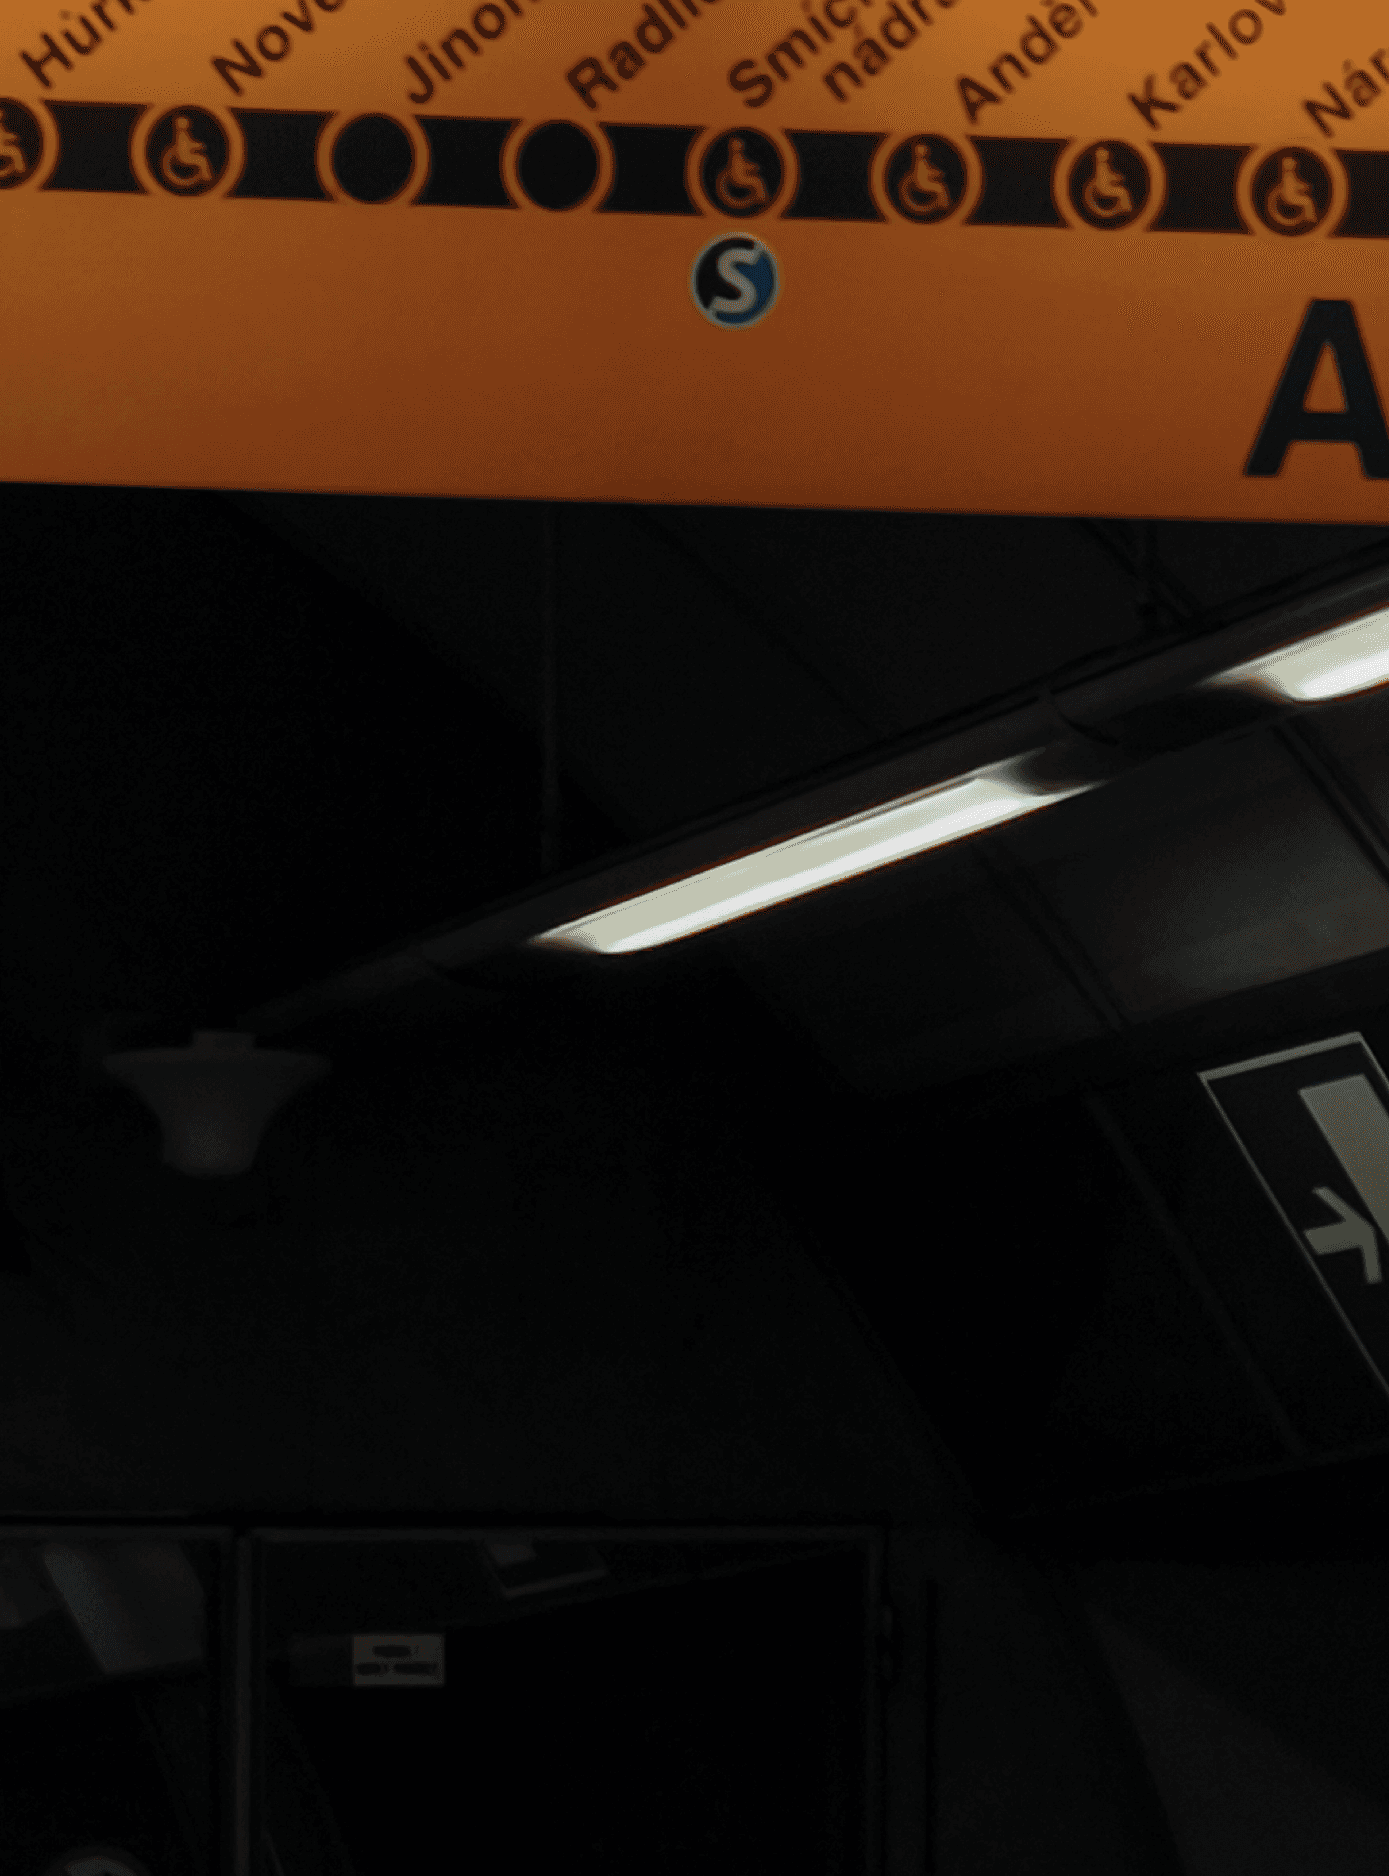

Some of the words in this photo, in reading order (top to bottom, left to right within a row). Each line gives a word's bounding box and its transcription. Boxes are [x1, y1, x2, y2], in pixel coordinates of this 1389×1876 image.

[727, 0, 872, 109] Smíc
[822, 0, 960, 103] nádr
[1243, 298, 1389, 480] A
